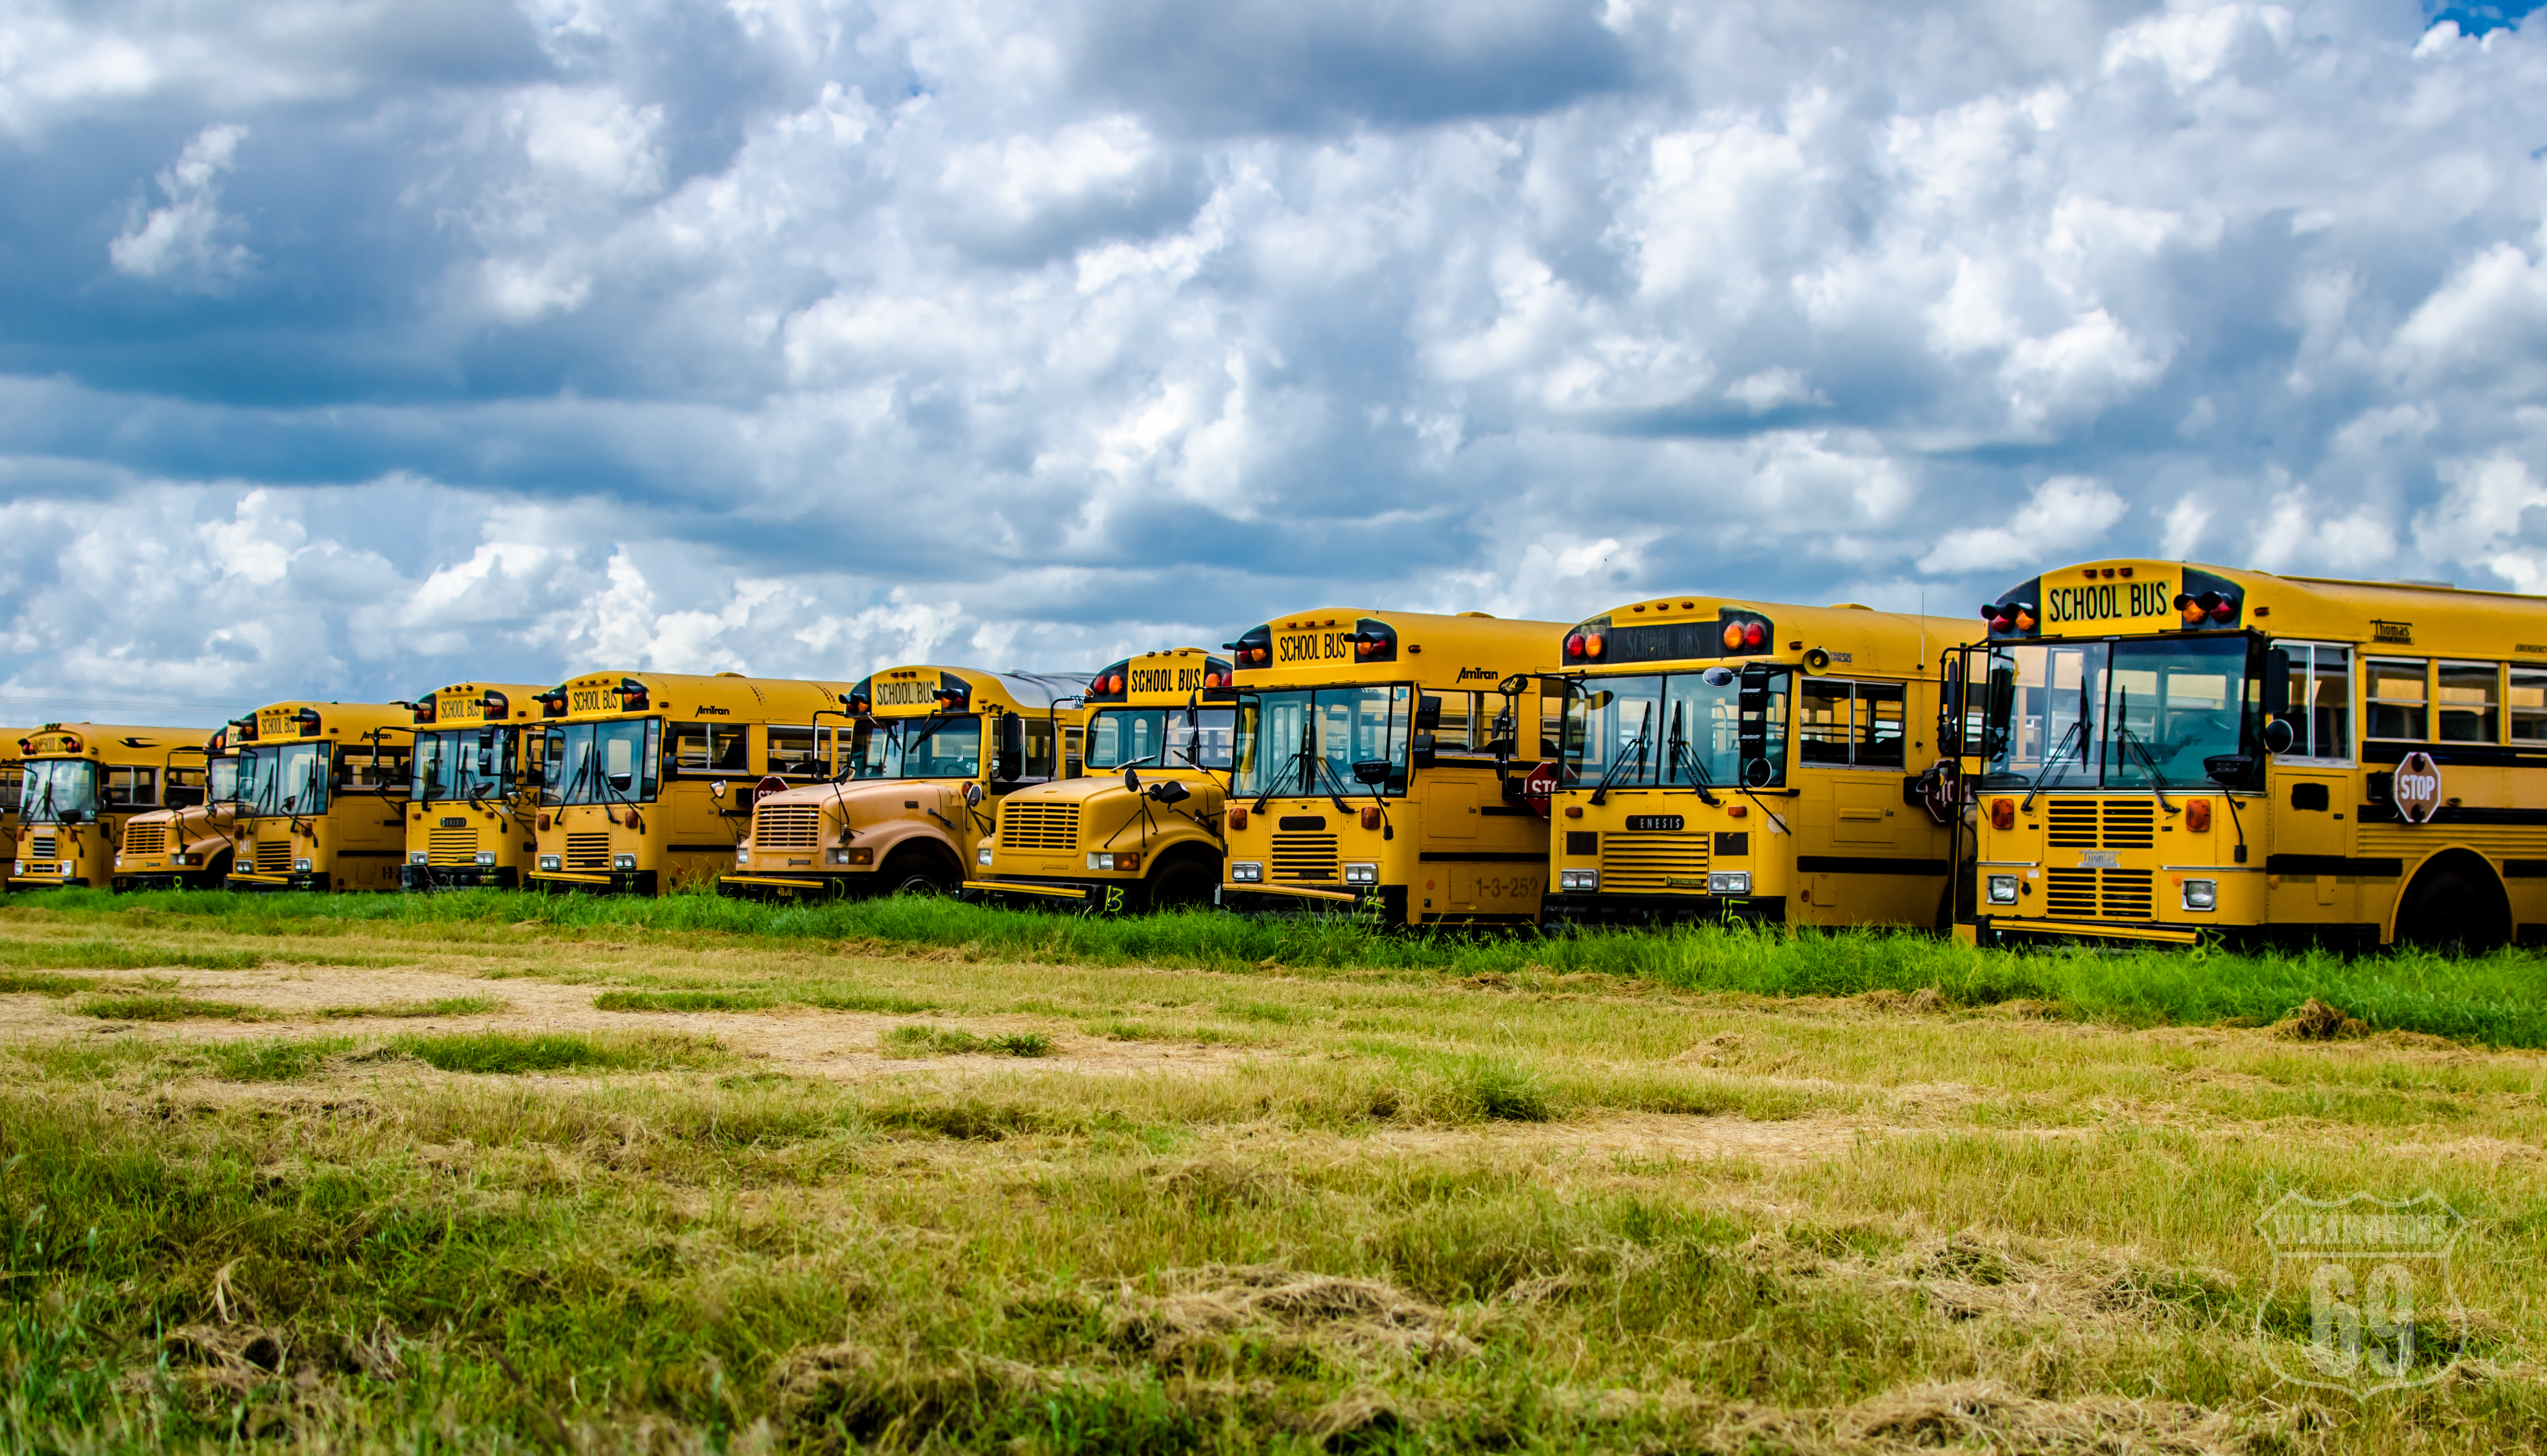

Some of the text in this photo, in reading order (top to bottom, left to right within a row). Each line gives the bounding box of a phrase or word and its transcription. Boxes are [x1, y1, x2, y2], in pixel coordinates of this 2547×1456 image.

[2050, 581, 2167, 622] SCHOOL BUS
[2370, 618, 2413, 636] Thomas
[1280, 632, 1346, 662] SCHOOL BUS
[1627, 624, 1701, 659] SCHOOL BUS
[1132, 668, 1200, 693] SCHOOL BUS
[1456, 667, 1498, 684] AmTran
[574, 689, 617, 712] SCHOOL BUS
[878, 681, 935, 706] SCHOOL BUS
[441, 699, 480, 718] SCHOOL BUS
[695, 705, 730, 718] AmTran
[262, 717, 283, 734] SCHOOL
[360, 731, 392, 742] Amran
[2401, 774, 2435, 800] STOP
[1640, 818, 1680, 829] ENESIS
[239, 840, 251, 853] 241
[1105, 885, 1124, 911] 13
[1476, 877, 1538, 898] 1-3-252
